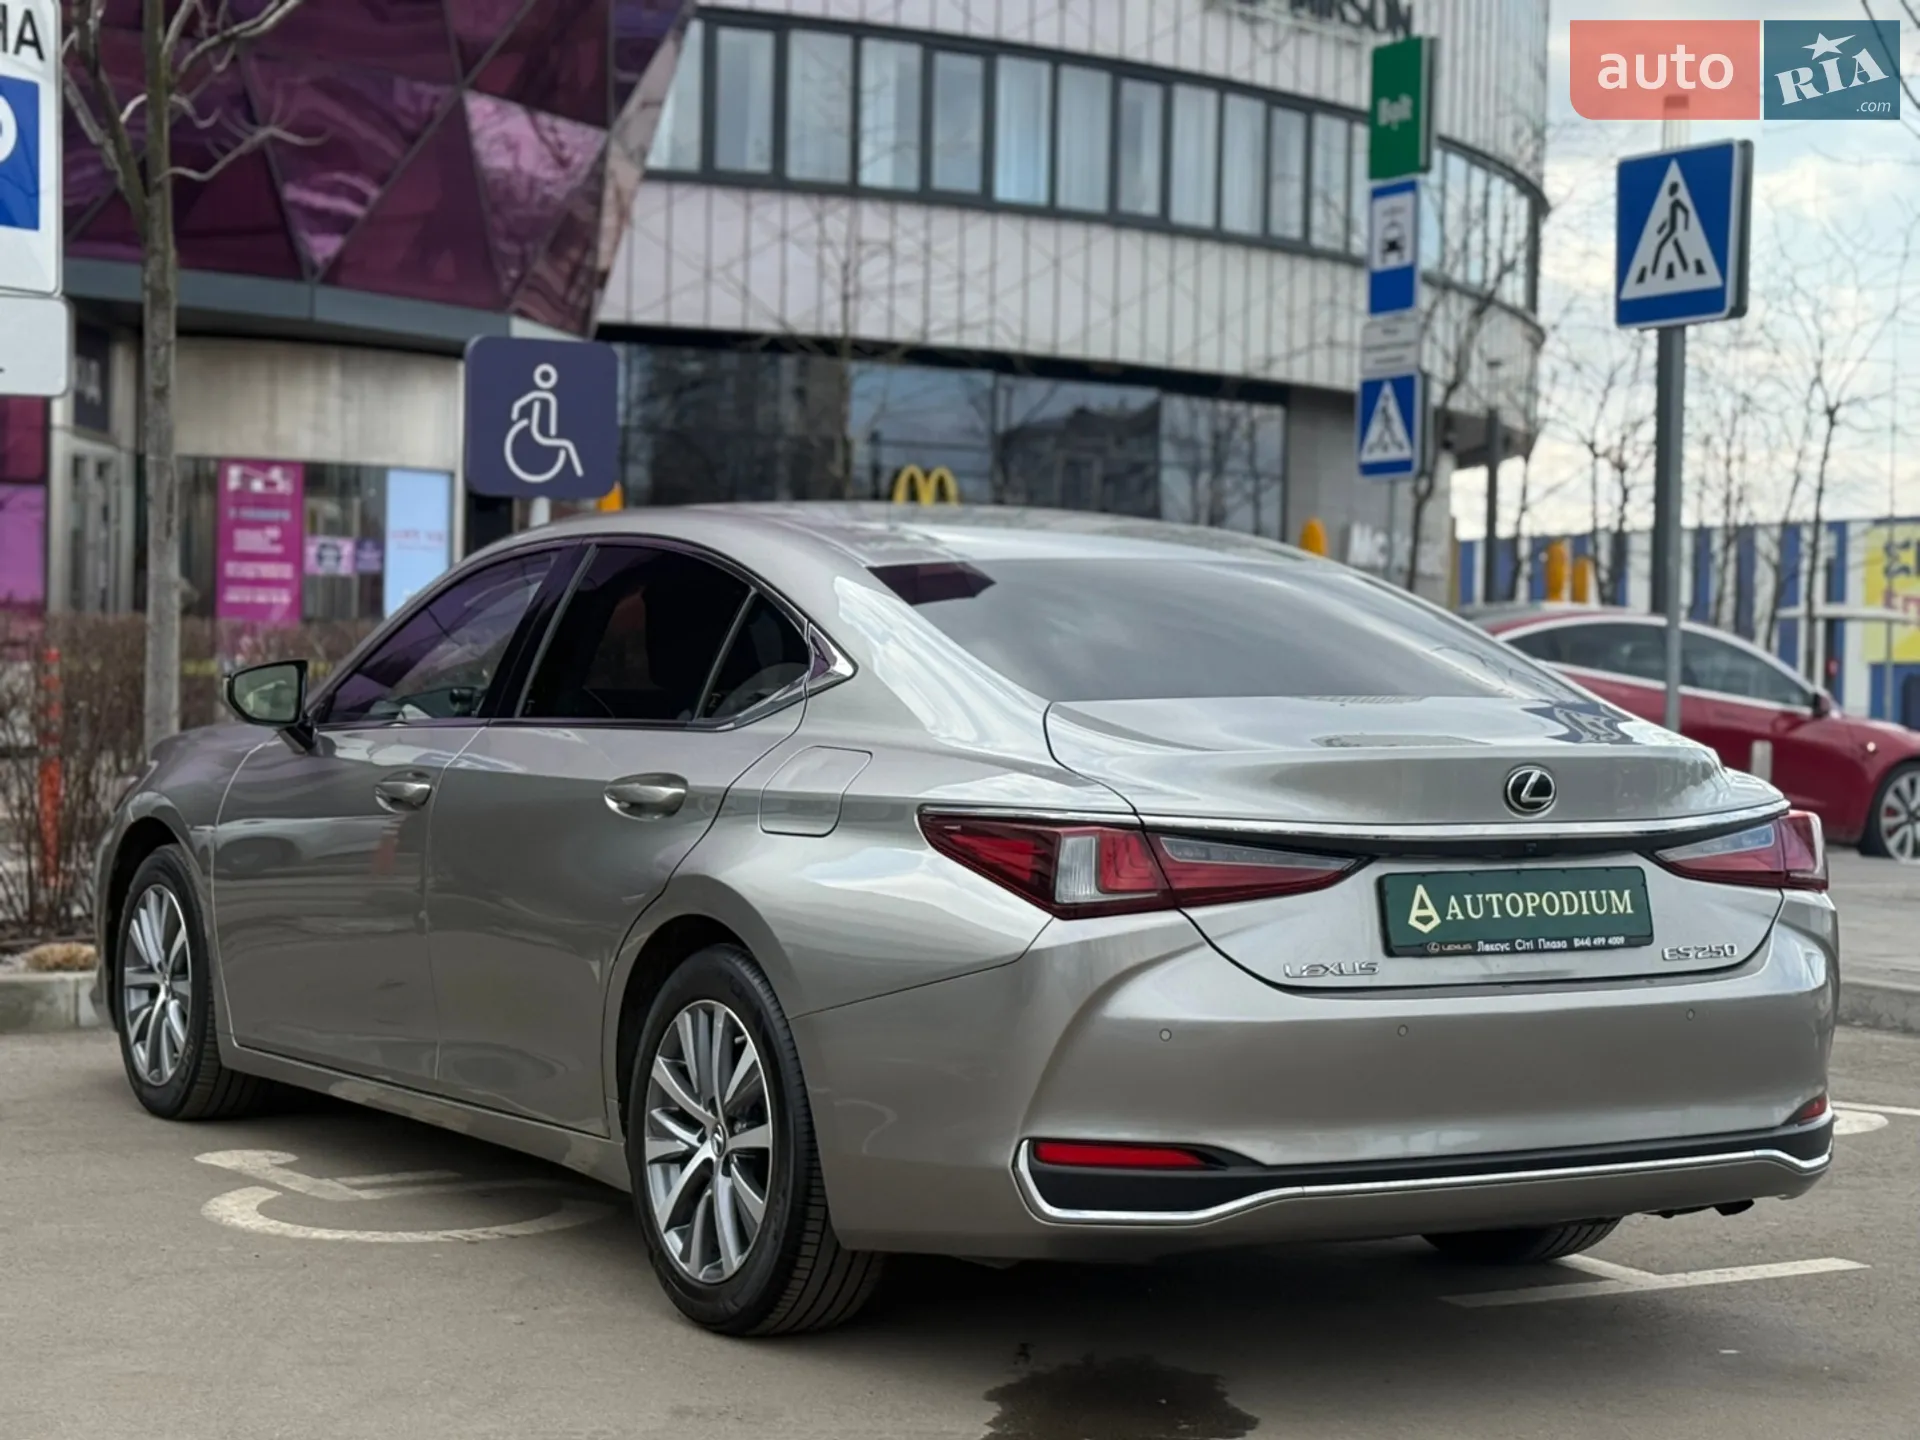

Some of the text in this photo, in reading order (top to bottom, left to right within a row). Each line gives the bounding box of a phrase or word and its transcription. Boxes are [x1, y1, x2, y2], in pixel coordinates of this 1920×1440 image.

[1446, 889, 1634, 920] AUTOPODIUM
[1476, 940, 1510, 952] Лексус
[1538, 938, 1567, 949] Плаза
[1283, 962, 1379, 978] LEXUS
